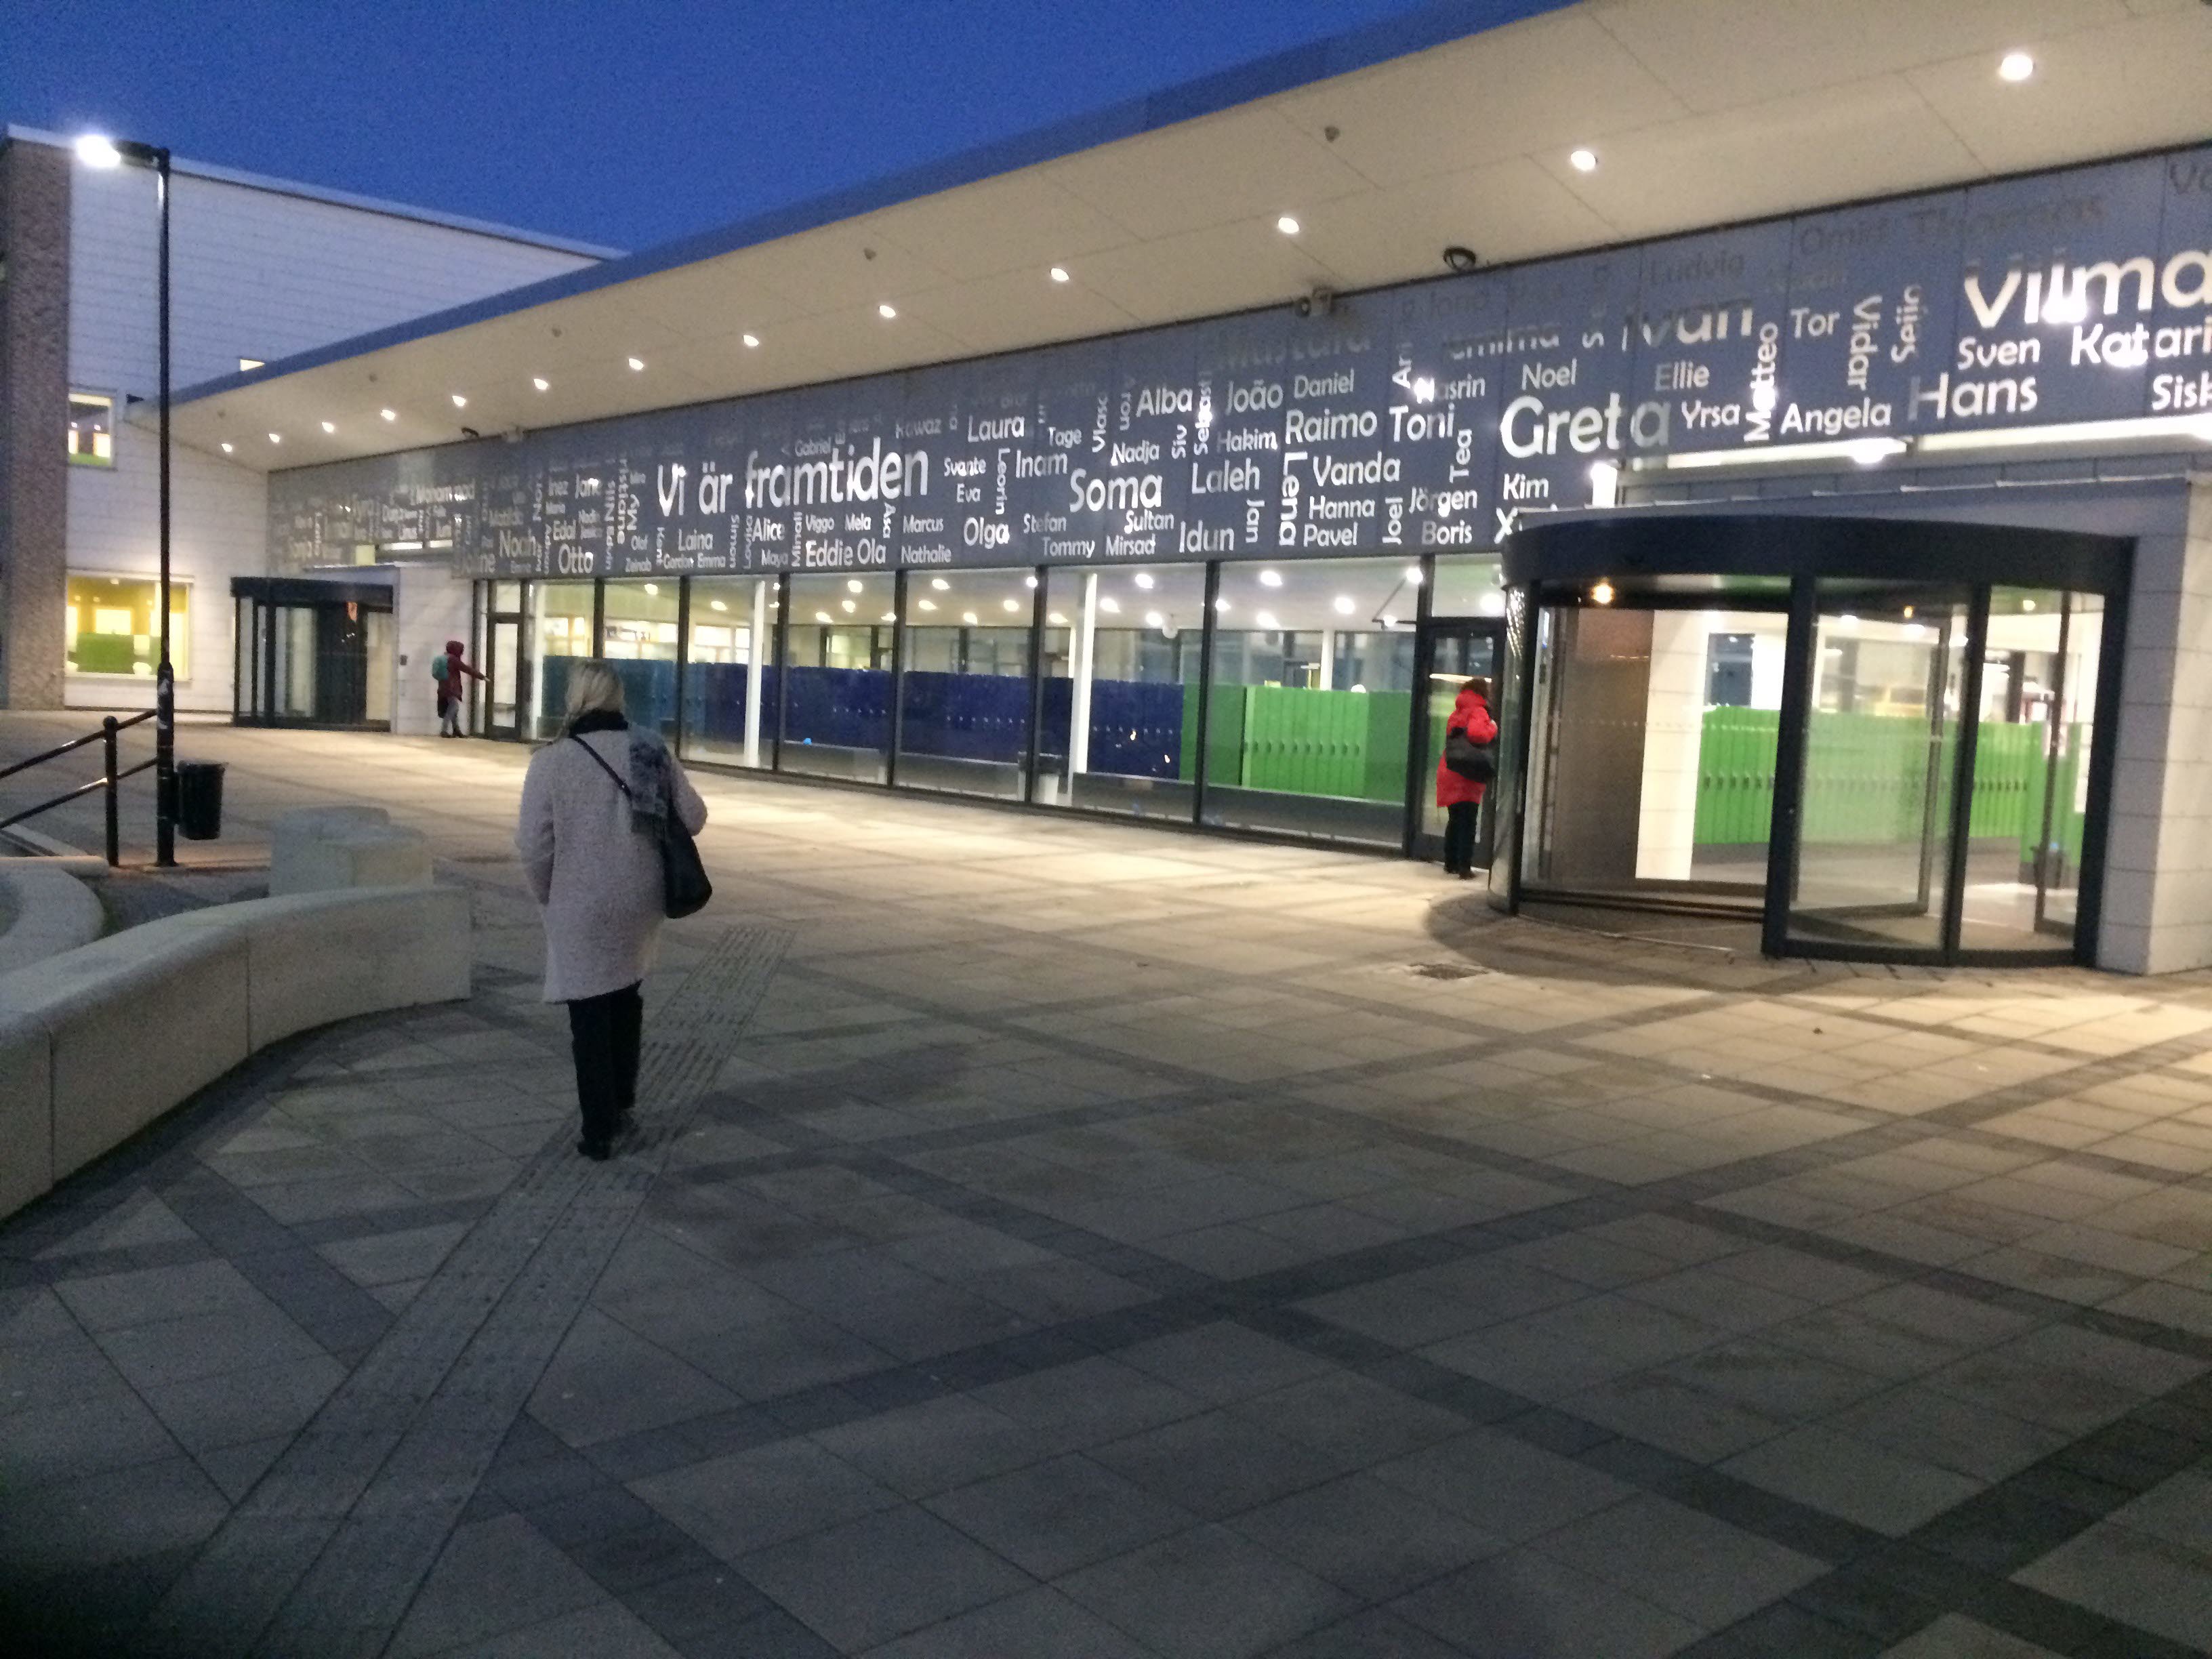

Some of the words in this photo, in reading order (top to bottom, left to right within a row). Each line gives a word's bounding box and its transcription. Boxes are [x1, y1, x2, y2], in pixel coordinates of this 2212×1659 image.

[1963, 252, 2212, 331] Vilma
[1790, 308, 1840, 339] Tor
[1847, 294, 1883, 391] Vidar
[1957, 335, 2041, 372] Sven
[1294, 368, 1354, 399] Daniel
[1521, 358, 1577, 390] Noel
[1655, 360, 1710, 391] Ellie
[1744, 322, 1780, 442] Matteo
[1136, 385, 1193, 417] Alba
[1225, 379, 1284, 416] João
[1908, 371, 2039, 422] Hans
[967, 414, 1025, 443] Laura
[1286, 408, 1377, 445] Raimo
[1389, 403, 1455, 443] Toni
[1500, 392, 1671, 458] Greta
[1681, 400, 1740, 429] Yrsa
[1780, 396, 1892, 435] Angela
[1049, 426, 1082, 448] Tage
[1172, 424, 1187, 459] Siv
[1216, 426, 1278, 454] Hakim
[944, 456, 987, 476] Svante
[1016, 449, 1068, 478] Inam
[1111, 440, 1160, 466] Nadja
[1449, 428, 1473, 483] Tea
[656, 462, 686, 517] Vi
[698, 460, 733, 514] är
[745, 435, 928, 508] framtiden
[1191, 457, 1260, 494] Laleh
[1313, 451, 1401, 487] Vanda
[956, 483, 981, 503] Eva
[1069, 468, 1163, 513] Soma
[1279, 451, 1308, 546] Lena
[1409, 486, 1478, 517] Jörgen
[1503, 473, 1549, 500] Kim
[805, 513, 835, 533] Viggo
[1023, 512, 1067, 534] Stefan
[1124, 510, 1174, 534] Sultan
[1245, 499, 1265, 543] Jan
[1309, 495, 1375, 520] Hanna
[1382, 496, 1403, 545] Joel
[752, 517, 785, 542] Alice
[903, 514, 944, 533] Marcus
[964, 517, 1010, 550] Olga
[1179, 519, 1235, 554] Idun
[1303, 521, 1358, 547] Pavel
[1422, 519, 1472, 546] Boris
[558, 544, 594, 575] Otto
[805, 537, 853, 567] Eddie
[857, 537, 886, 565] Ola
[901, 544, 952, 564] Nathalie
[1042, 535, 1095, 558] Tommy
[1105, 533, 1155, 557] Mirsad
